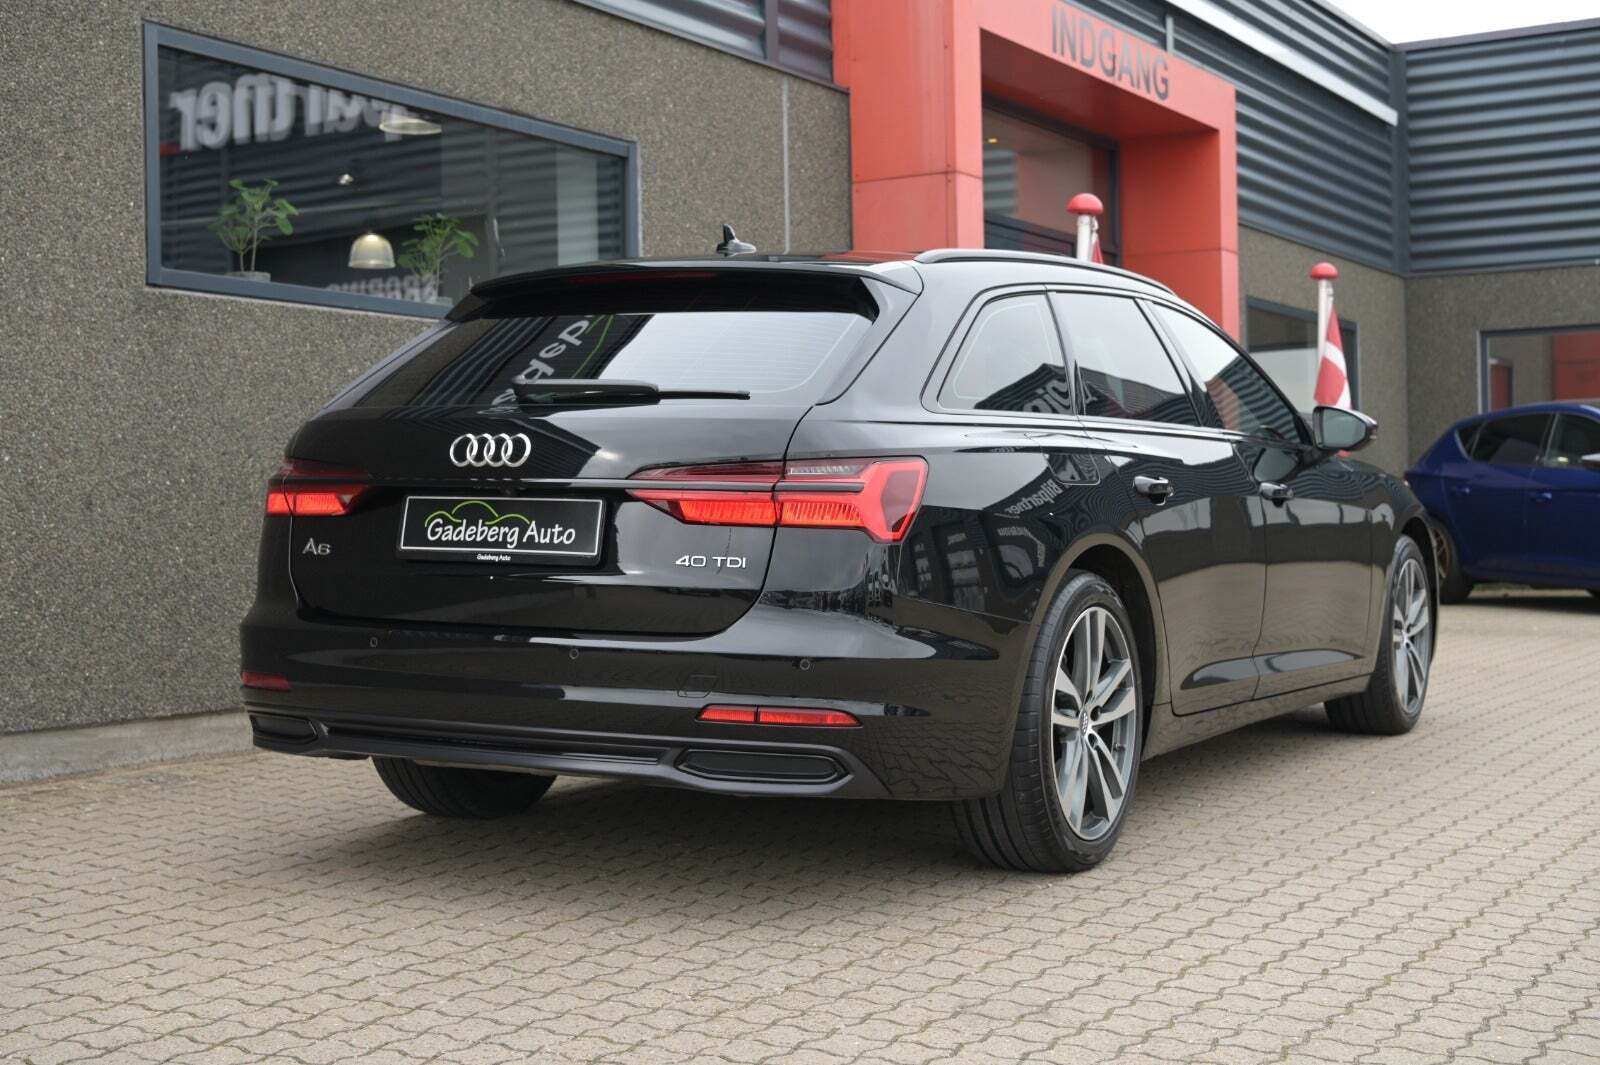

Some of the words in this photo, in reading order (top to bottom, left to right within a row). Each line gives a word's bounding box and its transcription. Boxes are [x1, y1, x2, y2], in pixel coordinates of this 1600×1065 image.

[1051, 4, 1169, 101] INDGANG
[427, 518, 519, 549] Gadeberg
[522, 520, 576, 545] Auto
[301, 537, 331, 555] A6
[675, 554, 706, 567] 40
[712, 556, 746, 568] TDI
